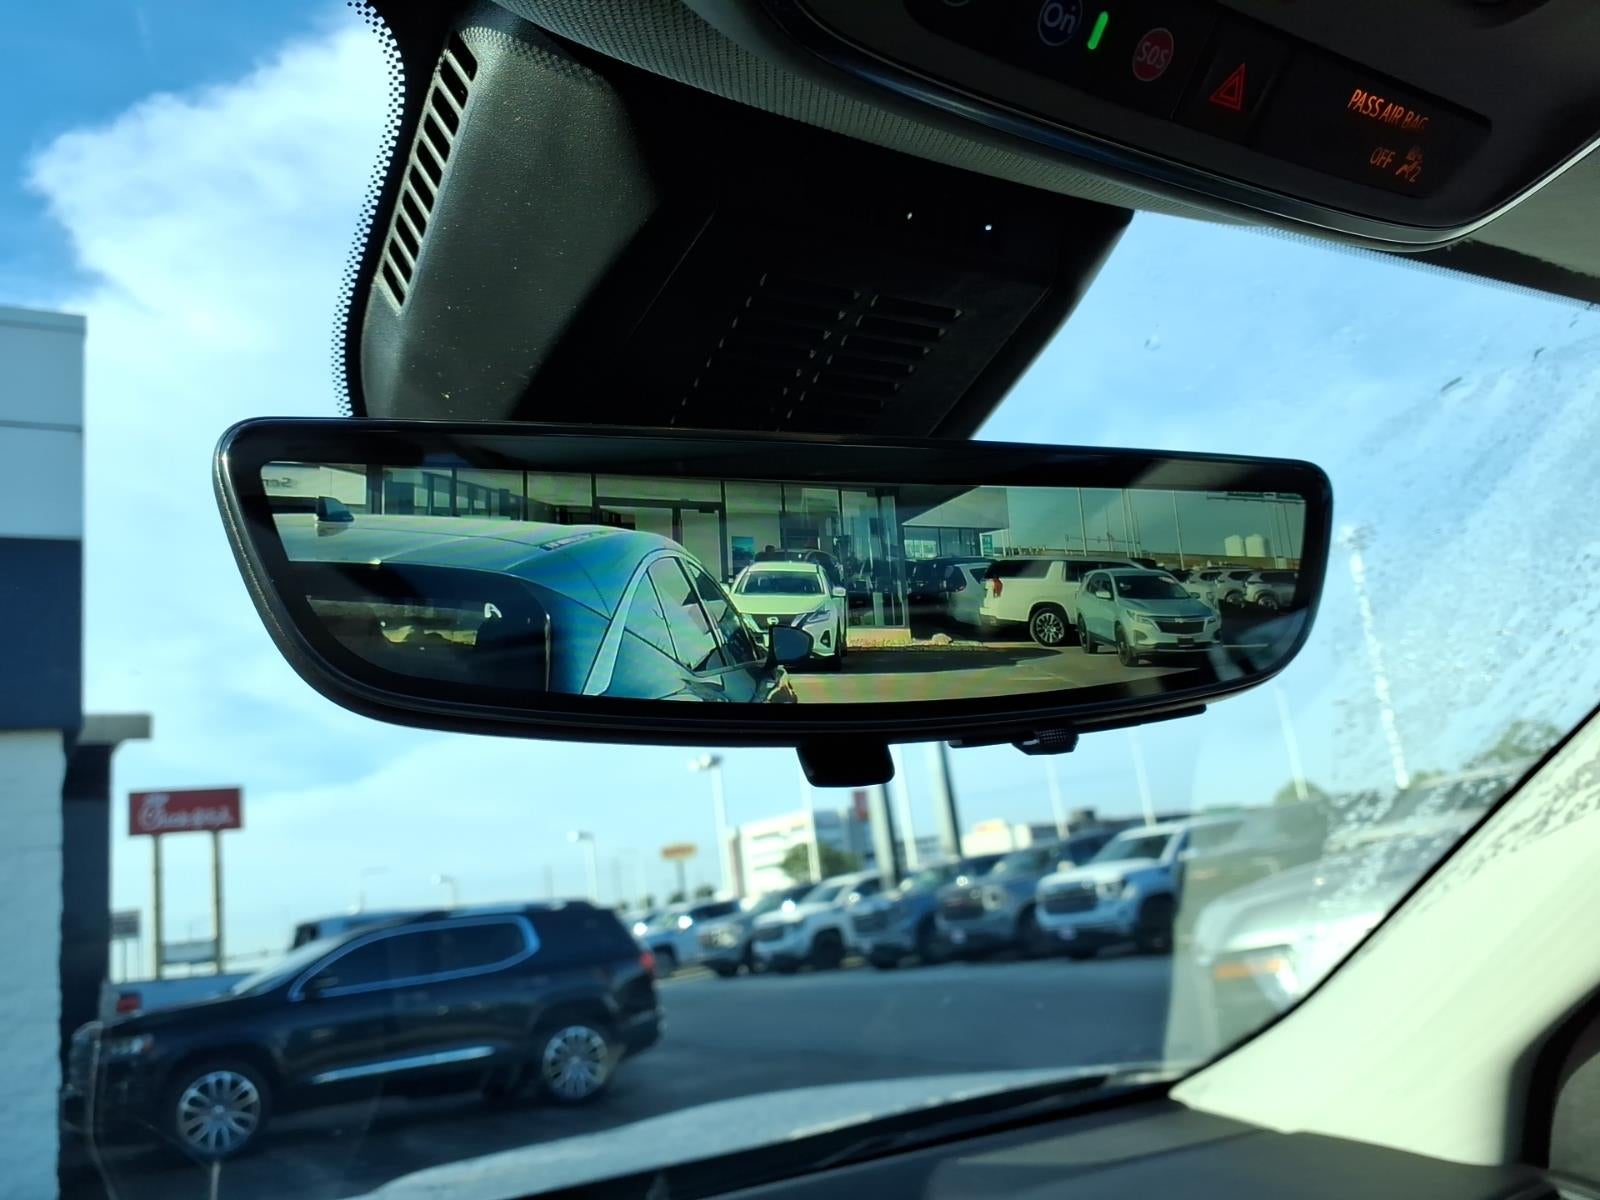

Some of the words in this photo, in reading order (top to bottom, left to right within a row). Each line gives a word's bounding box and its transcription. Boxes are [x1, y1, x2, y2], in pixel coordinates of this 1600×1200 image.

[1137, 42, 1169, 69] SOS
[1347, 88, 1385, 118] PASS
[1379, 103, 1405, 124] AIR
[1369, 147, 1396, 169] OFF
